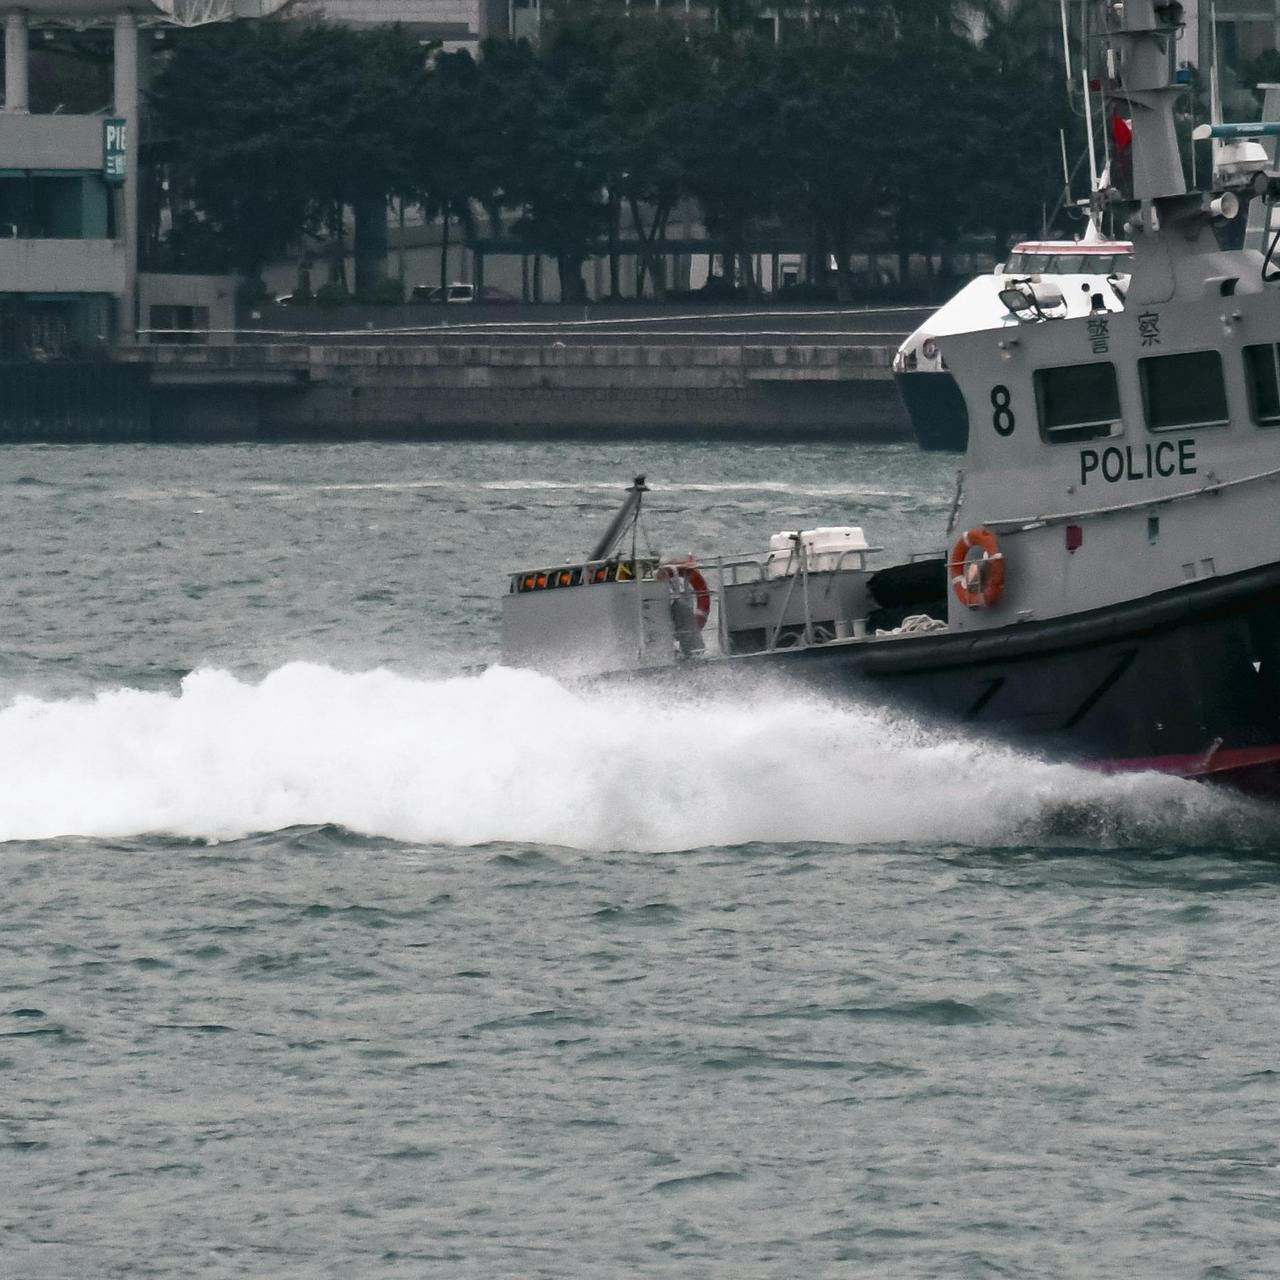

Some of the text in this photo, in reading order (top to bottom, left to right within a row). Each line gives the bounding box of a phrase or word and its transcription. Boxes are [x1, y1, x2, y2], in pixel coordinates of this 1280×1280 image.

[1086, 311, 1161, 354] 警察
[990, 384, 1015, 437] 8
[1080, 438, 1197, 486] POLICE
